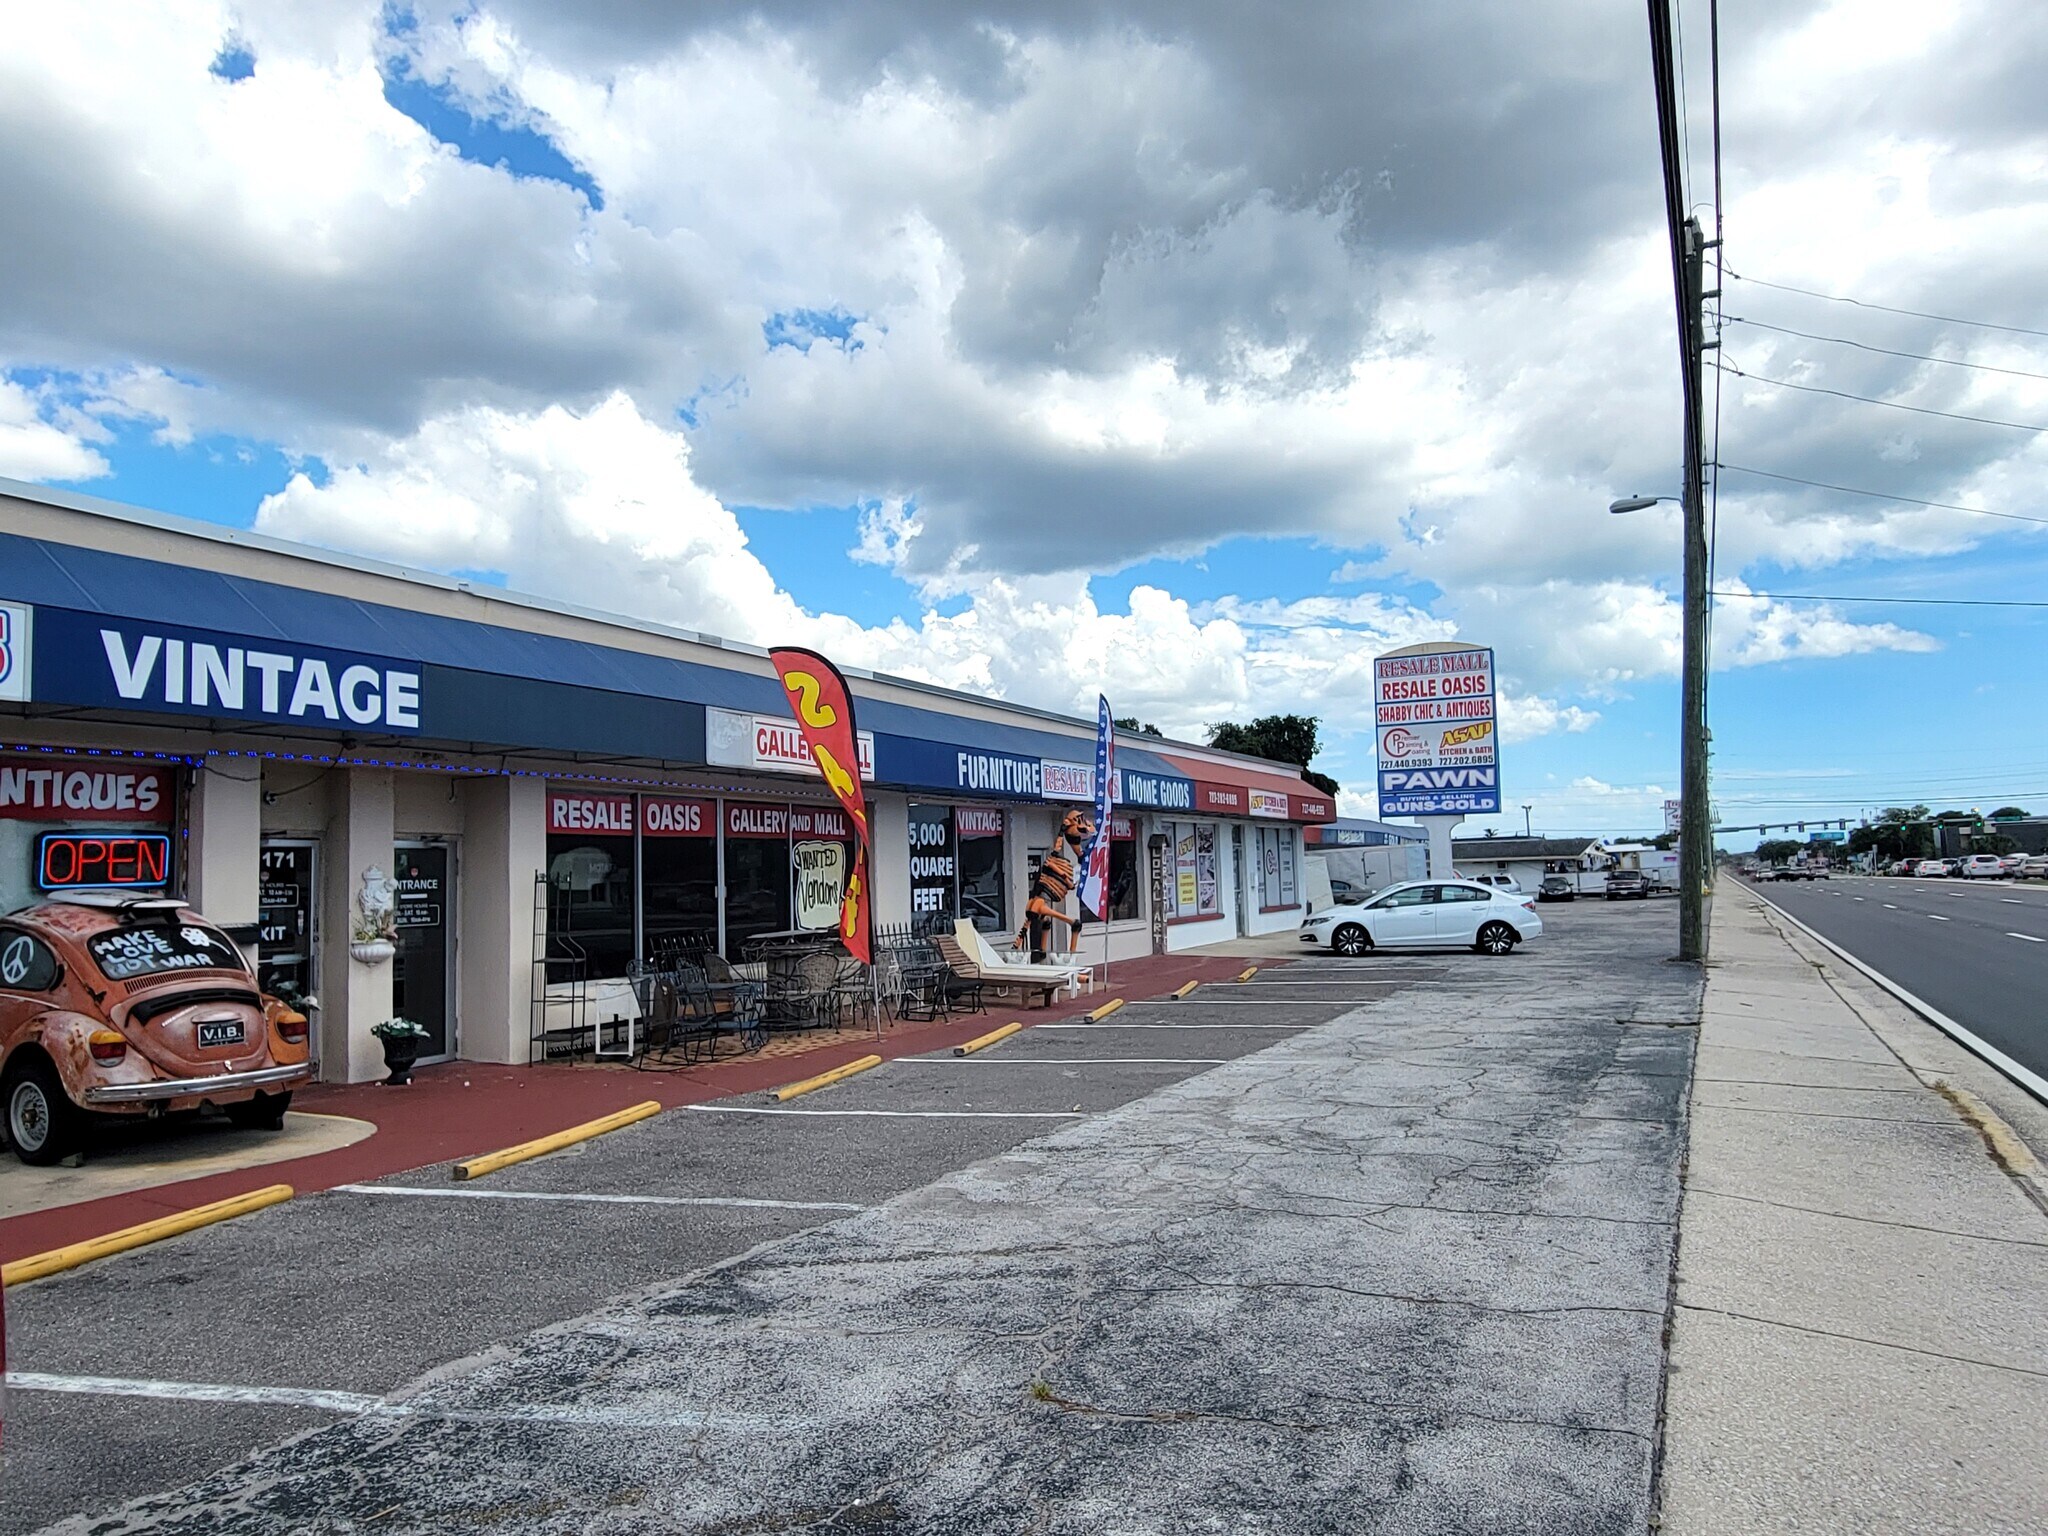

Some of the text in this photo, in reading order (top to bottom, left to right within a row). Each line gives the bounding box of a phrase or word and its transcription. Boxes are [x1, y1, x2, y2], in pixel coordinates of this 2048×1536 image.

[1377, 652, 1489, 679] RESALE MALL
[100, 629, 419, 728] VINTAGE
[1382, 675, 1486, 700] RESALE OASIS
[1378, 699, 1491, 723] SHABBY CHIC & ANTIQUES
[756, 728, 812, 761] GALLE
[1439, 721, 1492, 748] ASAP
[1380, 759, 1433, 769] 727.440.9393
[1439, 747, 1467, 756] KITCHEN
[1439, 755, 1494, 766] 727.202.6895
[957, 752, 1040, 794] FURNITURE
[1043, 764, 1088, 796] RESALE
[1384, 768, 1495, 791] PAWN
[0, 767, 160, 812] NTIQUES
[1128, 774, 1158, 805] HOME
[1160, 780, 1190, 808] GOODS
[553, 799, 847, 837] RESALE OASIS GALLERY AND MALL
[1382, 798, 1495, 813] GUNS-GOLD
[957, 810, 1002, 832] VINTAGE
[1112, 820, 1132, 837] TEMS
[908, 822, 946, 850] 5,000
[45, 839, 166, 882] OPEN
[801, 848, 838, 870] WANTED
[911, 856, 954, 879] QUARE
[397, 879, 438, 890] NTRANCE
[1152, 847, 1161, 902] LOCAL
[800, 870, 839, 913] Vendors
[913, 887, 945, 912] FEET
[260, 926, 287, 941] XIT
[1153, 912, 1162, 944] ART
[94, 929, 161, 955] MAKE
[106, 940, 174, 964] LOVE
[160, 953, 215, 968] WAR
[203, 1026, 242, 1040] V.I.B.
